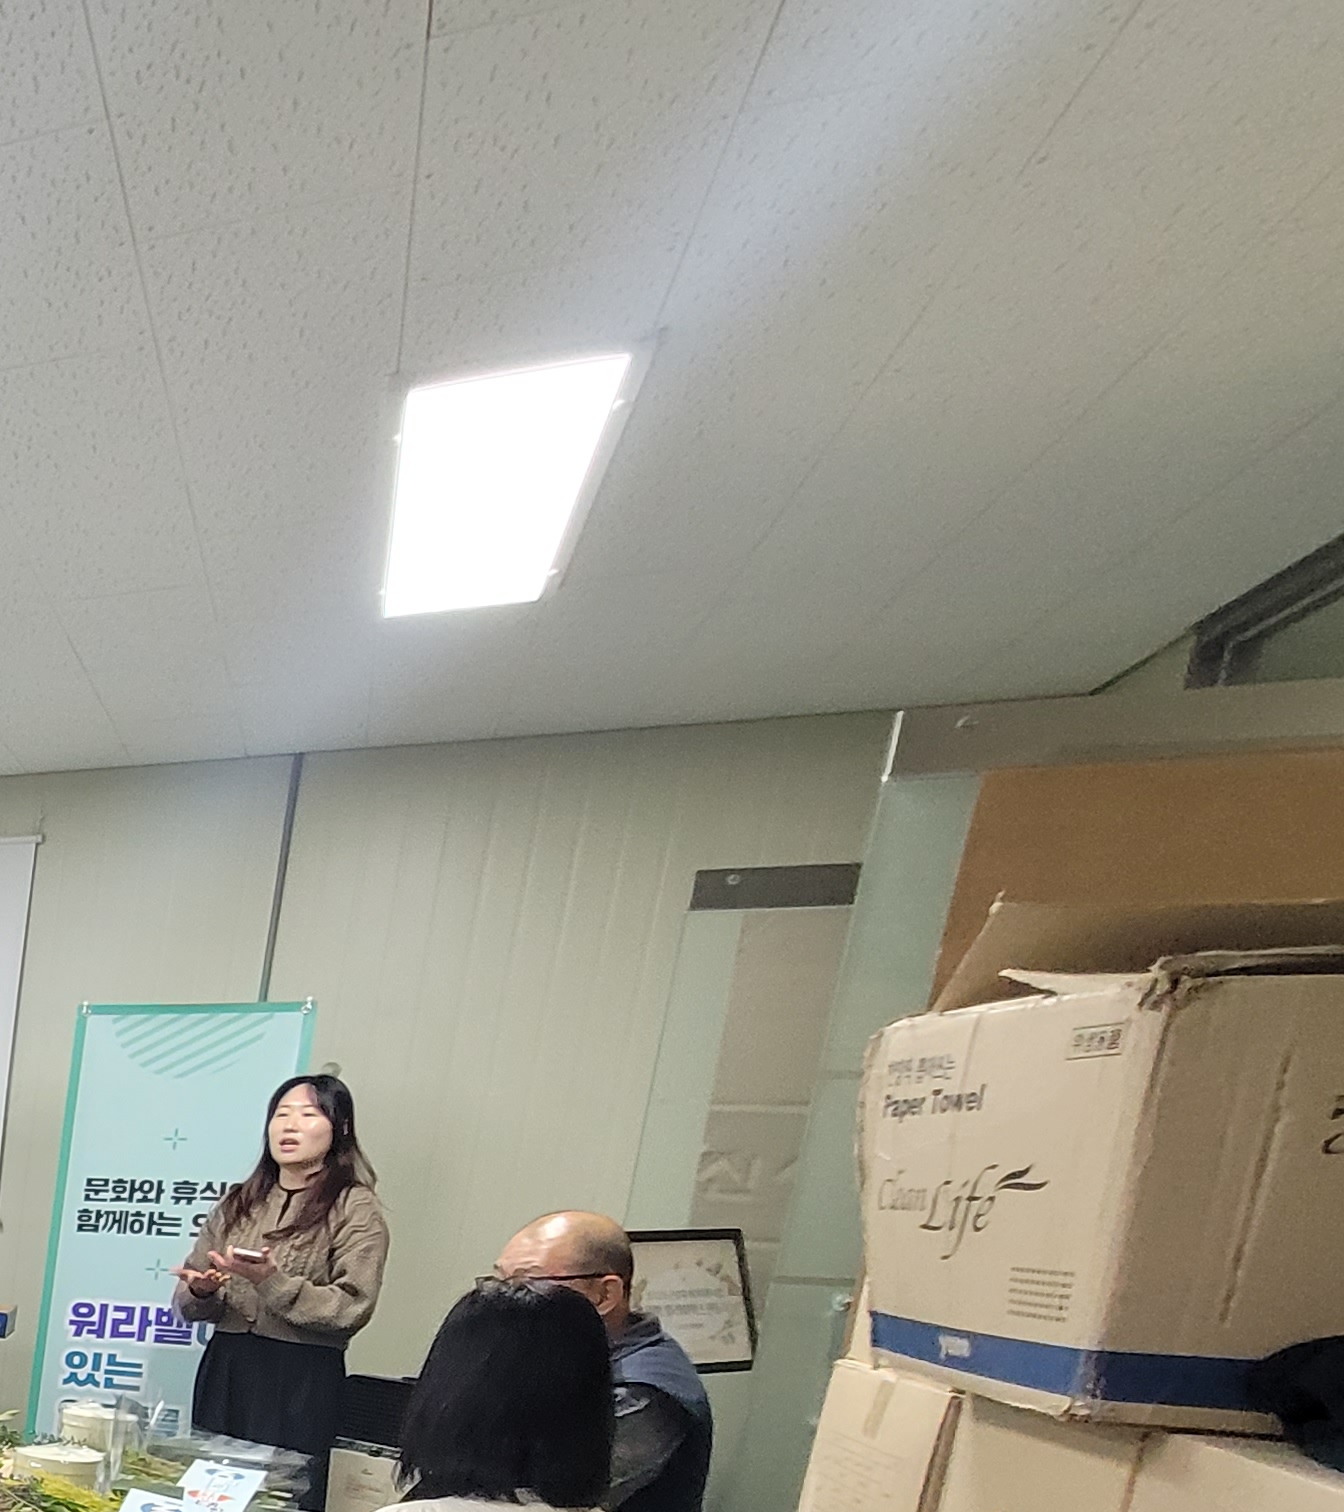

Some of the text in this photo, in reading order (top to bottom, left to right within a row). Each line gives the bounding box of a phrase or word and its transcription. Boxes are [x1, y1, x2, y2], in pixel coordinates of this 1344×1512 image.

[882, 1083, 988, 1123] Paper Towel
[82, 1177, 166, 1206] 문화와
[75, 1208, 182, 1238] 함께하는
[918, 1163, 1000, 1261] Life
[61, 1350, 144, 1391] 있는
